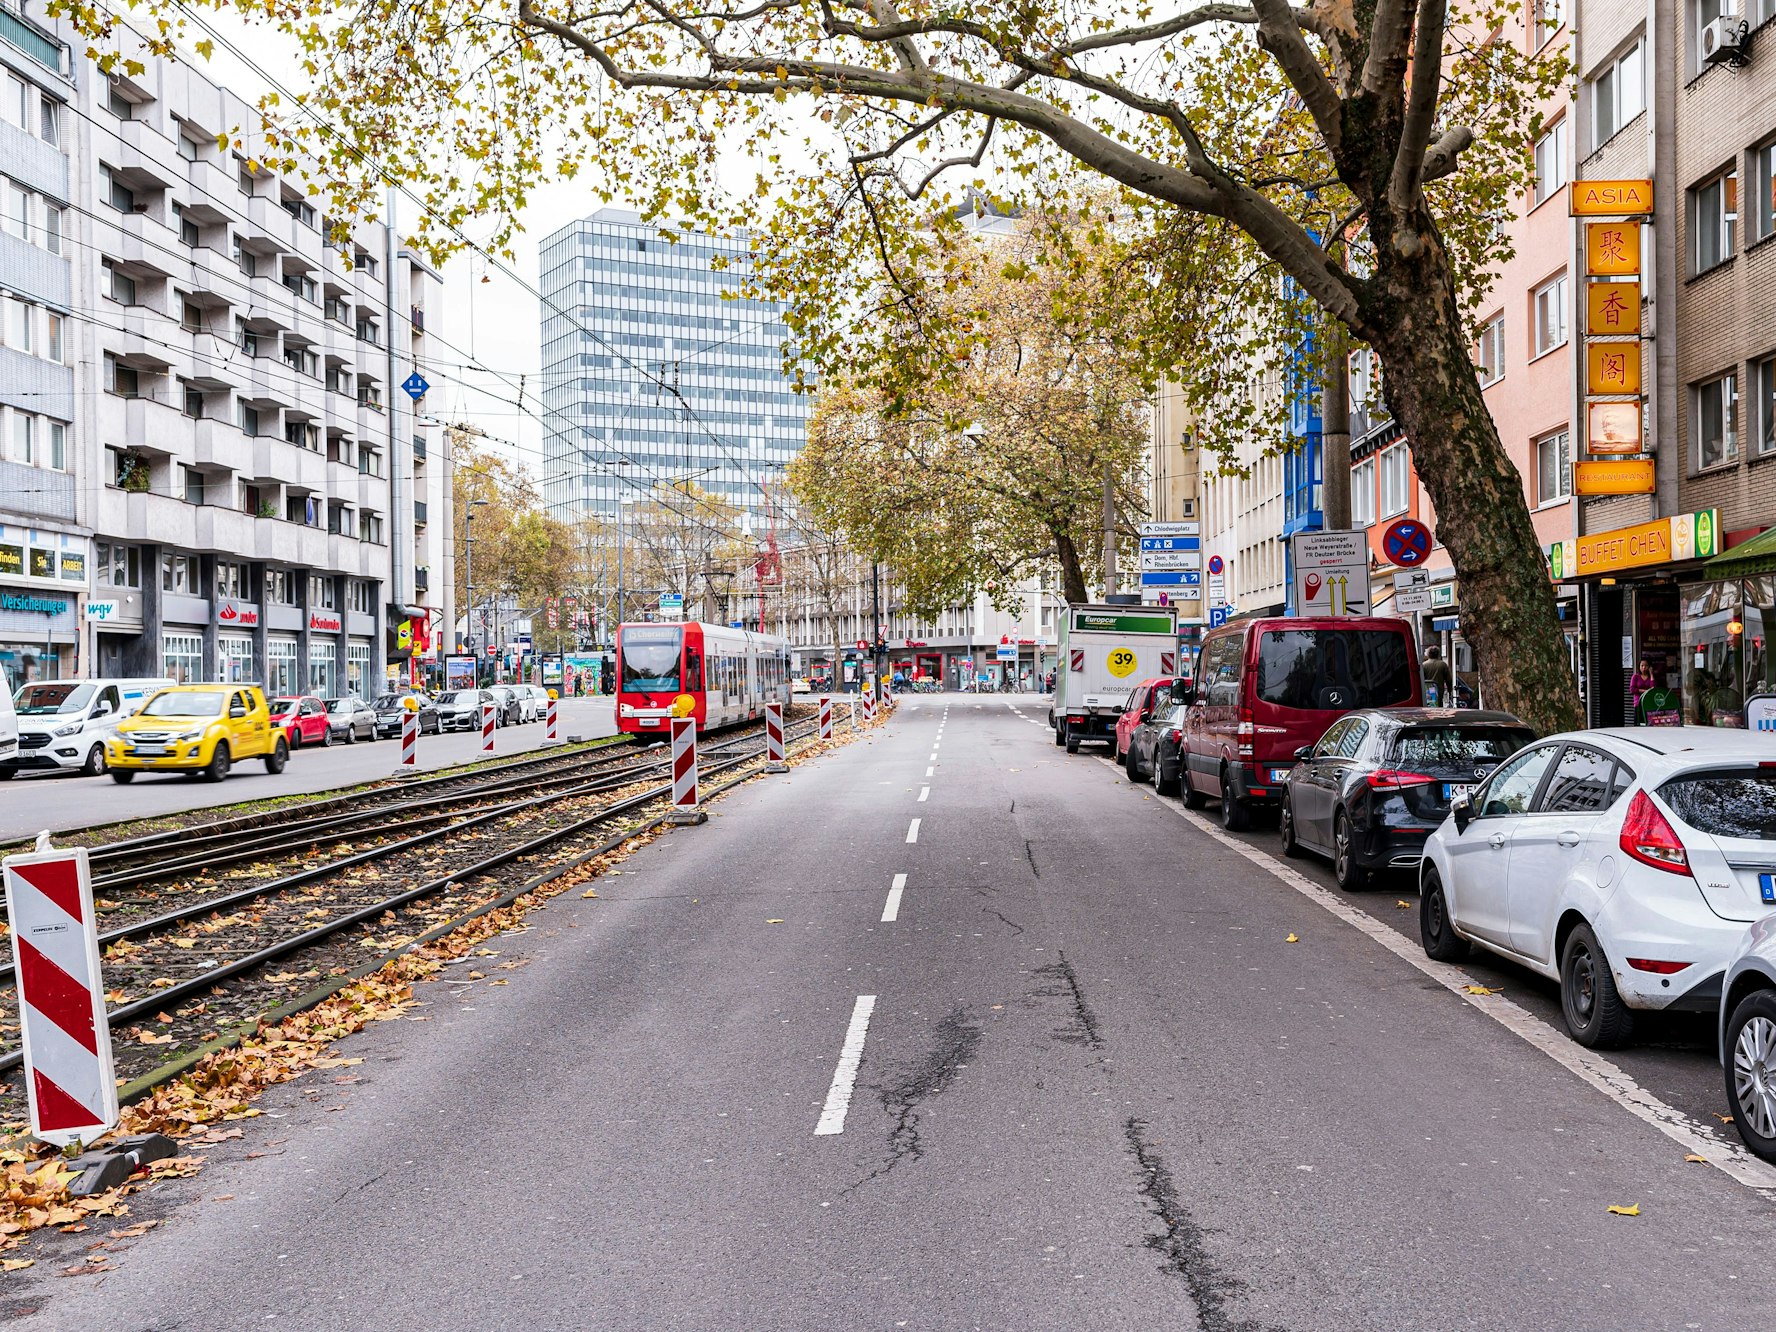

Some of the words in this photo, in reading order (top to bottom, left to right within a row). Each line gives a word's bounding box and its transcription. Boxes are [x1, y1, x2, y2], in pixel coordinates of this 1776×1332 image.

[1585, 188, 1641, 204] ASIA
[1579, 472, 1651, 482] RESTAURANT
[1154, 525, 1190, 533] Chlodwigplatz
[1311, 536, 1349, 544] Linksabbieger
[1319, 543, 1353, 551] Weyerstraße
[1580, 538, 1625, 565] BUFFET
[1629, 529, 1667, 556] CHEN
[37, 556, 48, 568] Sie
[62, 559, 83, 572] ARBEIT
[1, 593, 67, 616] Versicherungen
[88, 603, 113, 620] wgv
[1085, 615, 1117, 624] Europcar
[1213, 611, 1223, 626] P
[1114, 653, 1133, 665] 39
[1451, 785, 1458, 796] K
